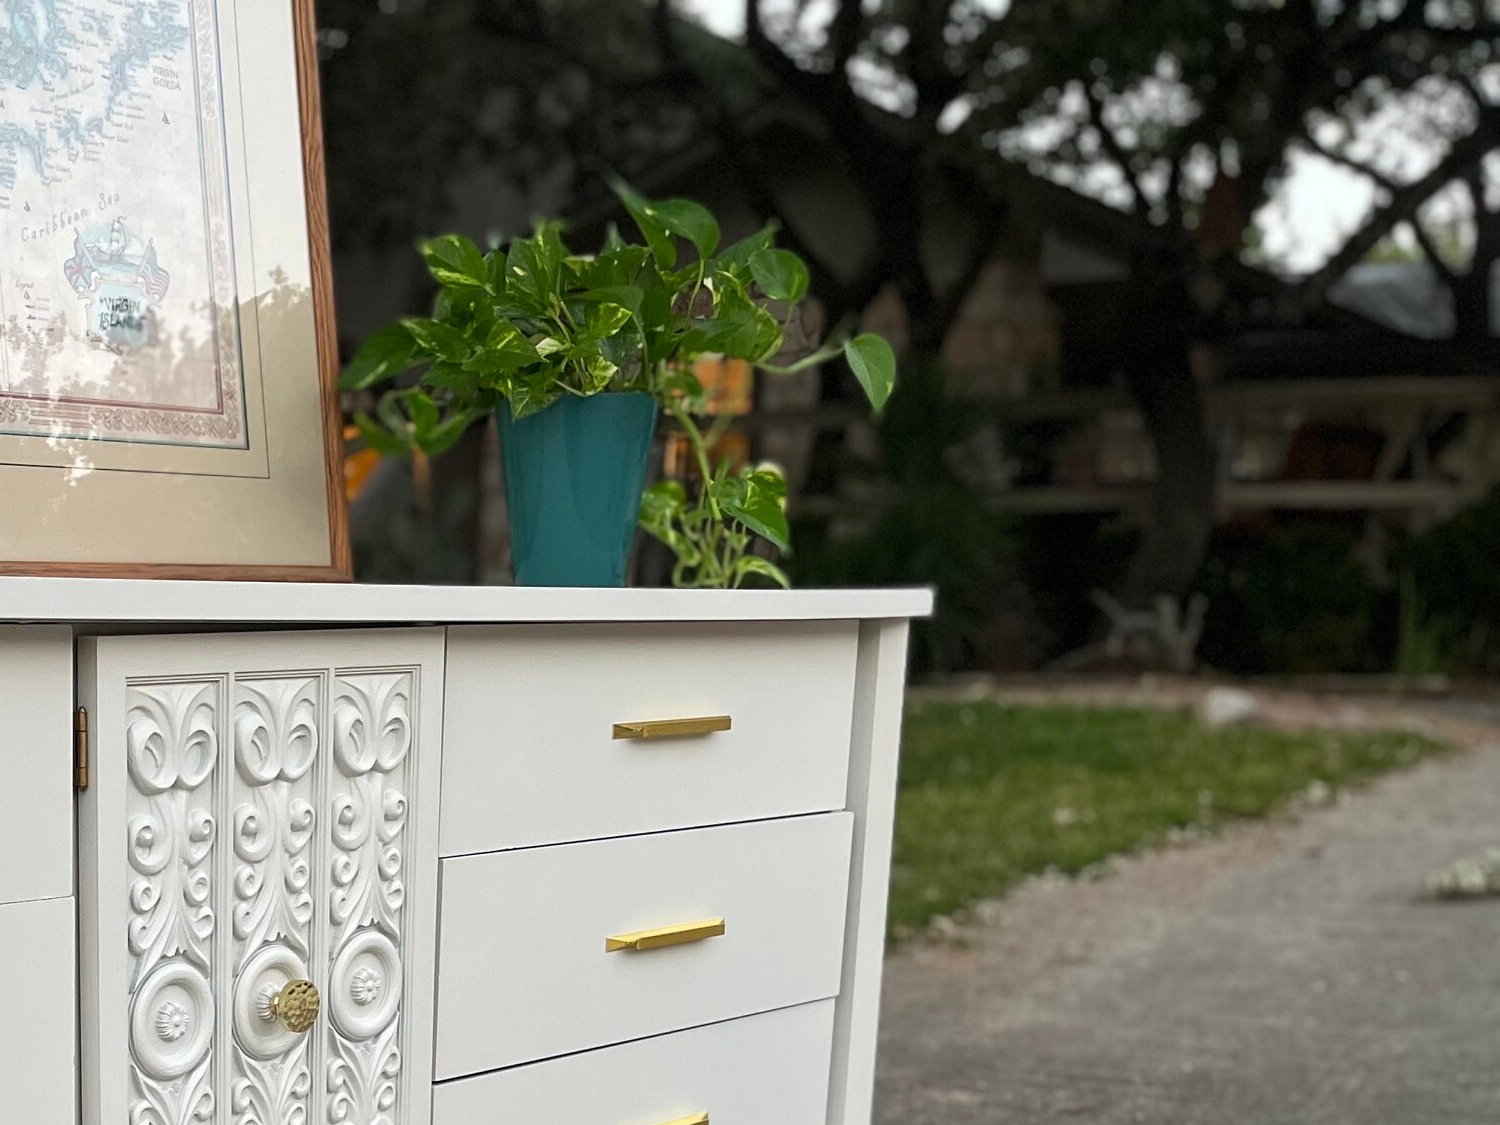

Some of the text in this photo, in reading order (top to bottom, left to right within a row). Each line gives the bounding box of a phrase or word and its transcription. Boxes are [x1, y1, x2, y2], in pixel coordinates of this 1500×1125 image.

[151, 65, 180, 80] VIRGIN
[152, 76, 182, 92] GORDA
[21, 207, 88, 242] Caribbean
[99, 296, 141, 314] VIRGIN
